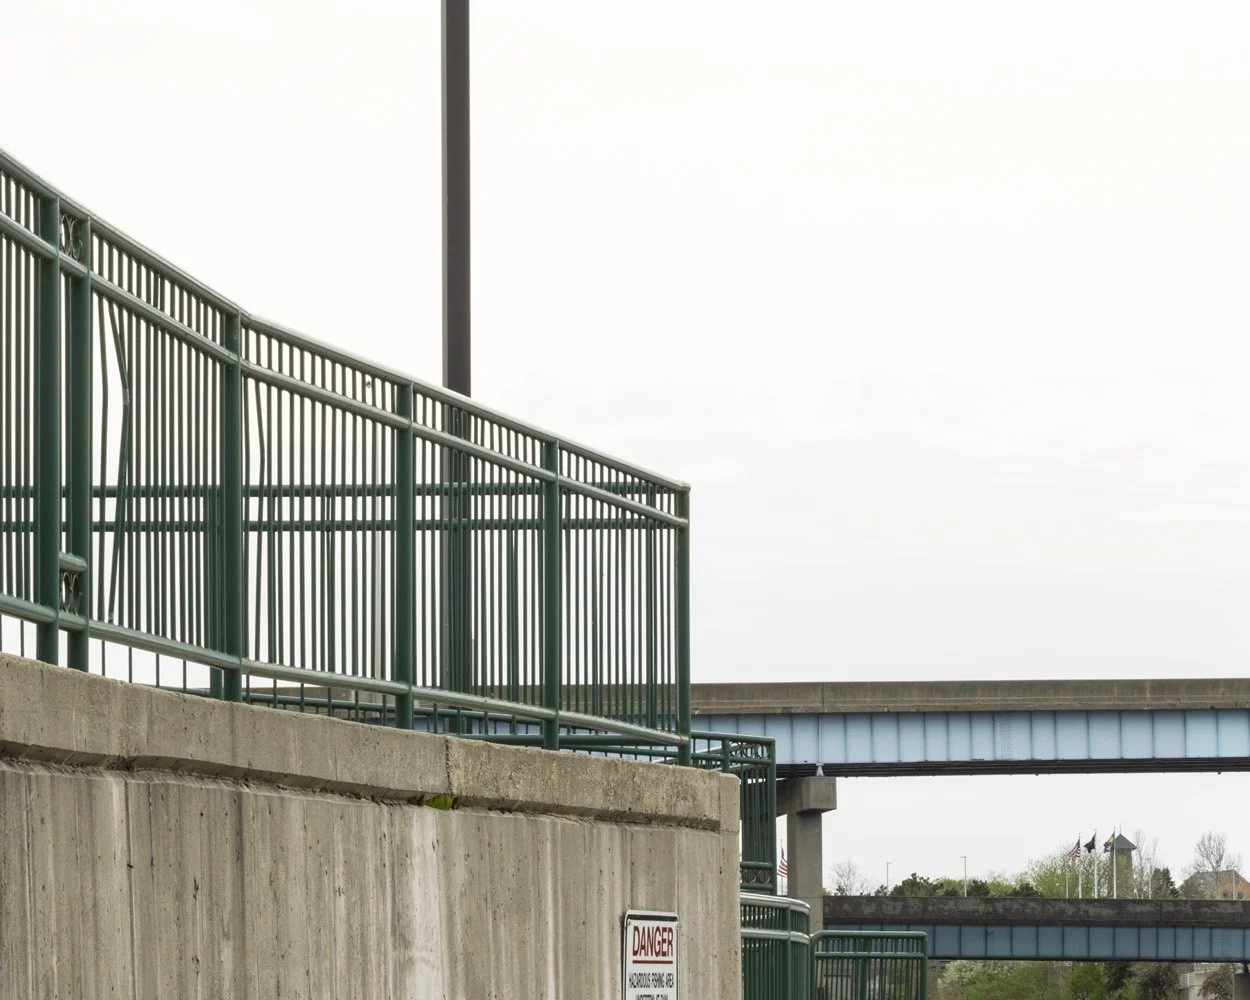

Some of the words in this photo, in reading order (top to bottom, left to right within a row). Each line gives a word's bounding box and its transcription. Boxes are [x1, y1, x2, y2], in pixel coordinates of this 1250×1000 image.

[632, 925, 674, 957] DANGER
[629, 972, 650, 988] HAZARDOUS
[651, 972, 664, 988] FISHING
[665, 972, 674, 988] AREA
